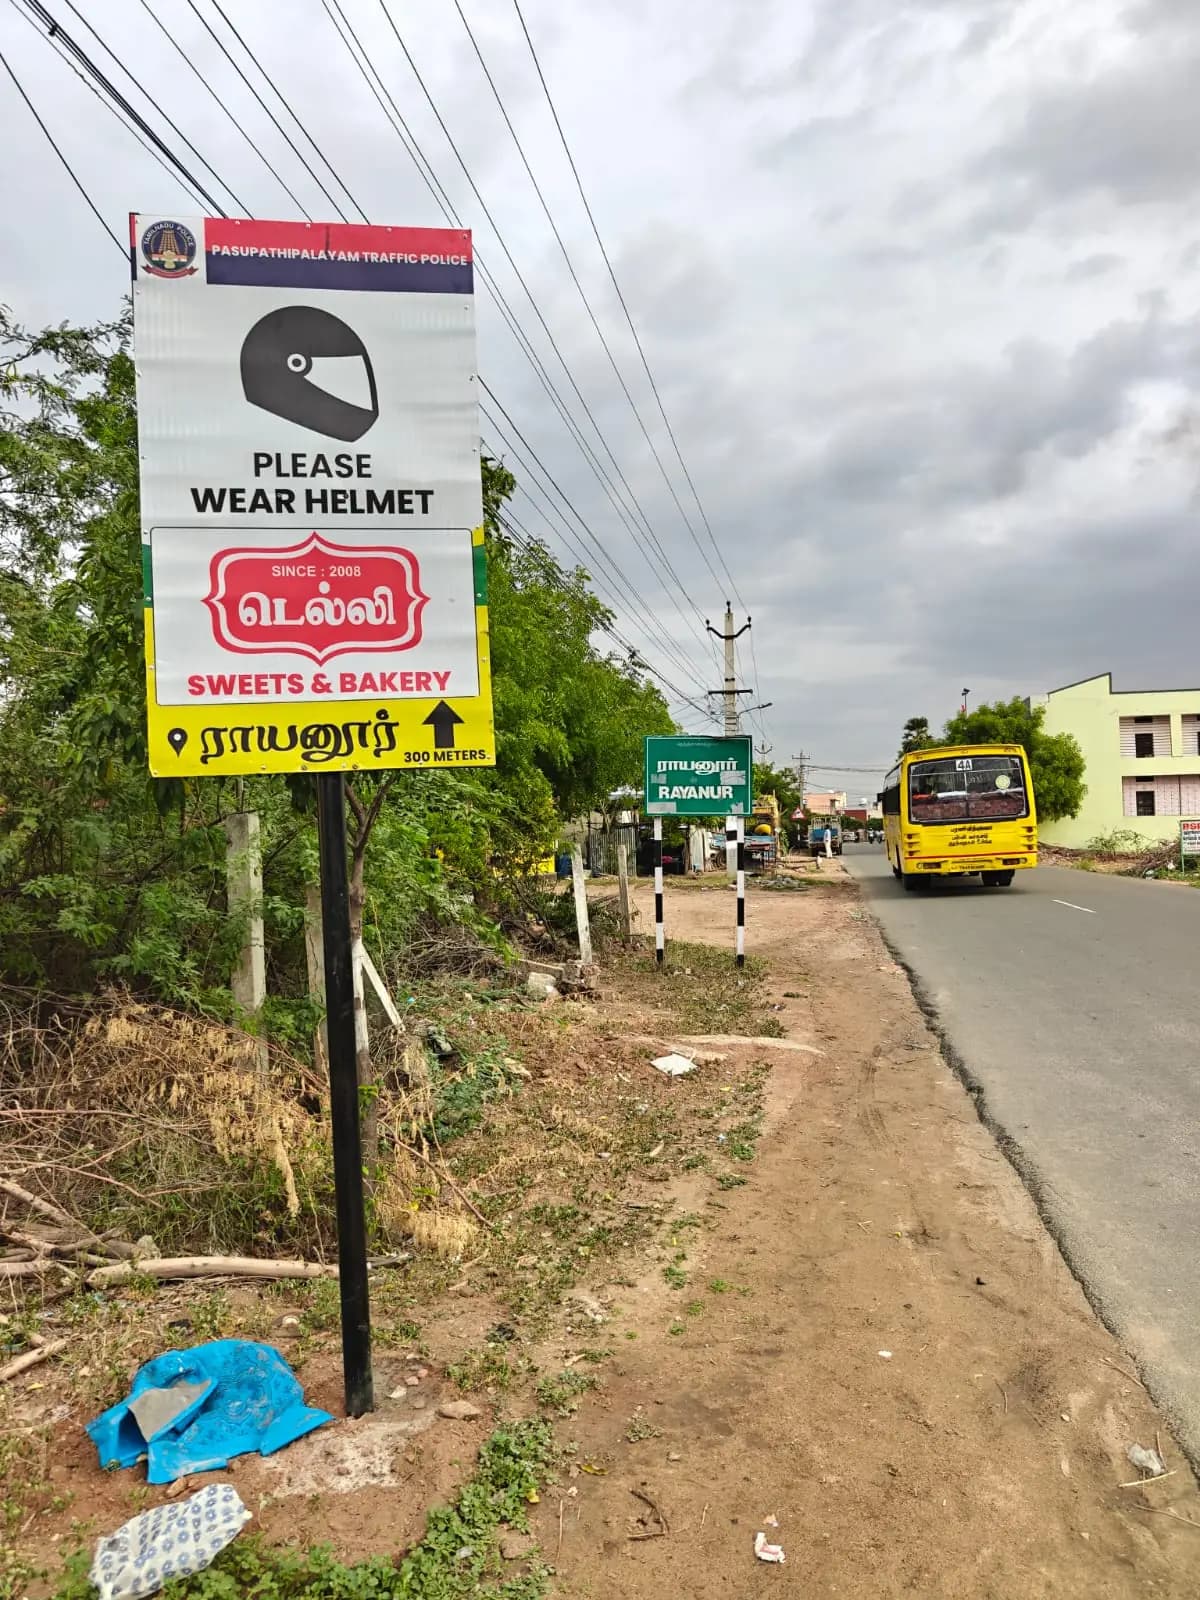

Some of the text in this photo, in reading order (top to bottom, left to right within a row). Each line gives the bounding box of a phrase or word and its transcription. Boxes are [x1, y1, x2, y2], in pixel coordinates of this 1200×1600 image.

[143, 223, 194, 247] TAMILNADU POLICE
[211, 244, 468, 266] PASUPATHIPALAYAM TRAFFIC POLICE
[253, 452, 372, 479] PLEASE
[190, 487, 435, 515] WEAR HELMET
[271, 565, 317, 577] SINCE
[329, 565, 362, 577] 2008
[238, 581, 397, 627] டெல்லி
[187, 671, 453, 696] SWEETS & BAKERY
[200, 708, 400, 765] ராயனூர்
[403, 751, 431, 763] 300
[656, 757, 739, 776] ராயனூர்
[957, 759, 973, 770] 4A
[658, 785, 734, 799] RAYANUR
